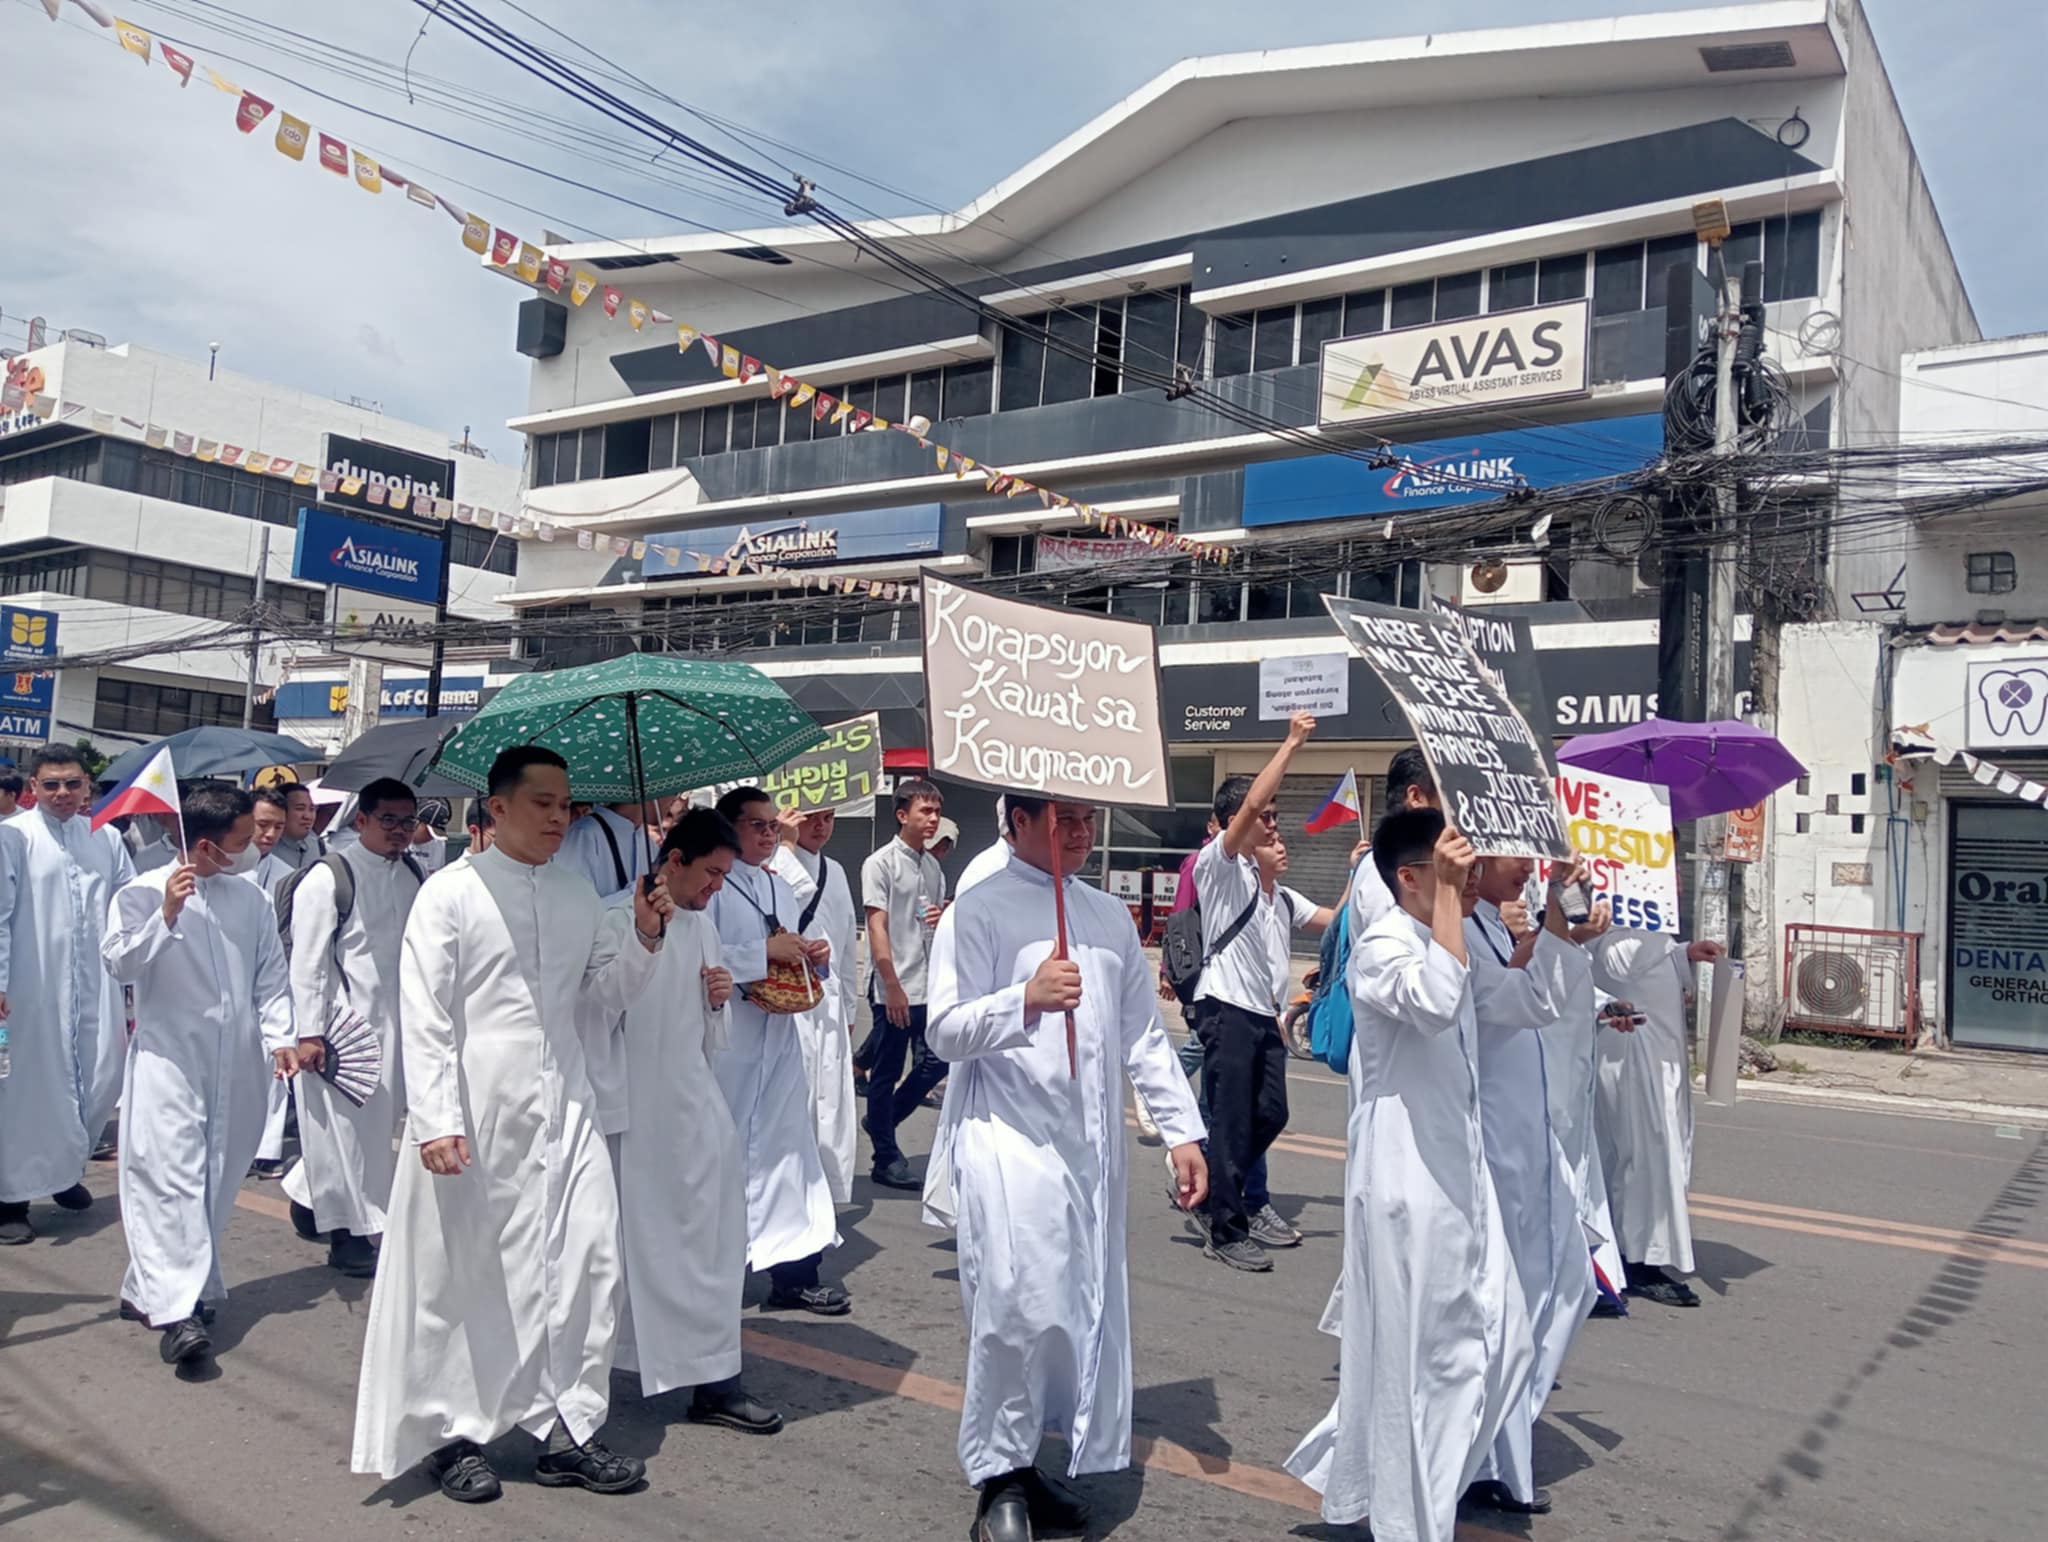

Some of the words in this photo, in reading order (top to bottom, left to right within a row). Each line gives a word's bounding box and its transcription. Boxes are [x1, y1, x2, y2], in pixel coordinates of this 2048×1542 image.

[1410, 320, 1563, 386] AVAS
[1437, 381, 1471, 398] VIRTUAL
[1473, 375, 1518, 392] ASSISTANT
[1519, 368, 1563, 386] SERVICES
[336, 535, 419, 576] ASIALINK
[731, 526, 837, 556] ASIALINK
[928, 581, 1148, 680] Korapsyon
[1350, 614, 1435, 651] THERE
[1430, 622, 1467, 657] IS
[1367, 645, 1412, 674] NO
[1405, 650, 1480, 684] TRUE
[961, 658, 1089, 731] Kawat
[1092, 695, 1143, 733] sa
[1185, 705, 1247, 718] Customer
[1409, 674, 1497, 711] PEACE
[0, 715, 41, 736] ATM
[1184, 719, 1231, 731] Service
[1408, 701, 1484, 738] WITHOUT
[939, 703, 1157, 790] Kaugmaon
[761, 758, 848, 792] RIGHT
[774, 770, 872, 810] LEAD
[1472, 795, 1564, 843] SOLIDARITY
[1568, 818, 1675, 869] ODESTLY
[1969, 975, 2048, 992] GENERAL
